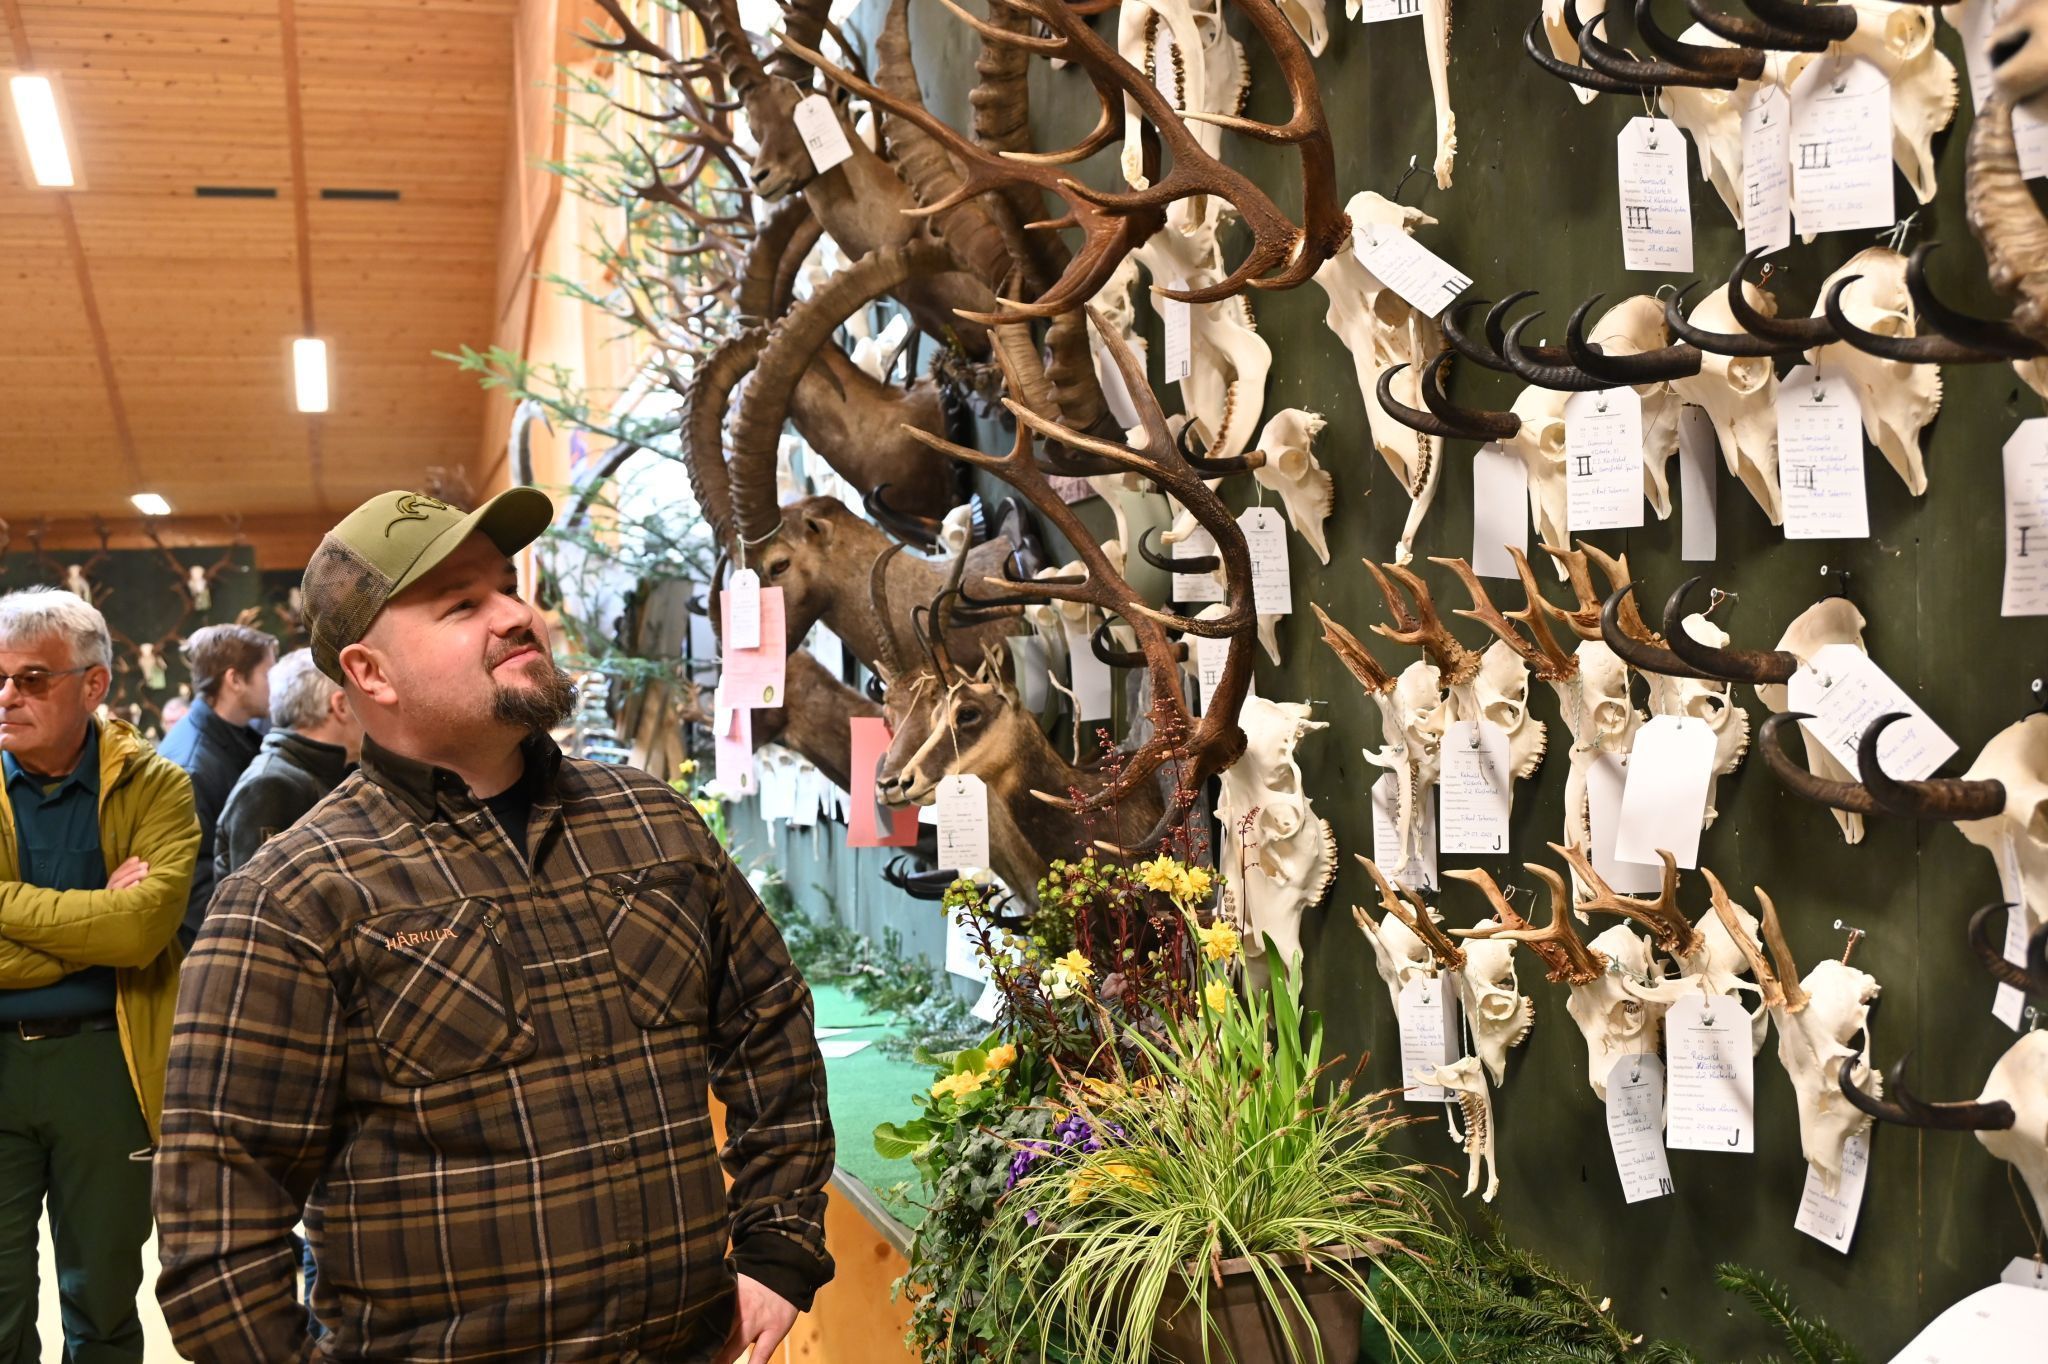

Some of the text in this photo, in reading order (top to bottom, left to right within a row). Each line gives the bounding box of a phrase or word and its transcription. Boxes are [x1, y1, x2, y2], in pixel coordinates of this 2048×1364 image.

[1798, 142, 1832, 170] III
[1626, 205, 1651, 230] III
[1576, 455, 1592, 477] II
[1792, 464, 1817, 490] III
[1492, 834, 1502, 851] J
[385, 928, 459, 952] HÄRKILA
[1727, 1128, 1740, 1147] J
[1835, 1221, 1846, 1241] J
